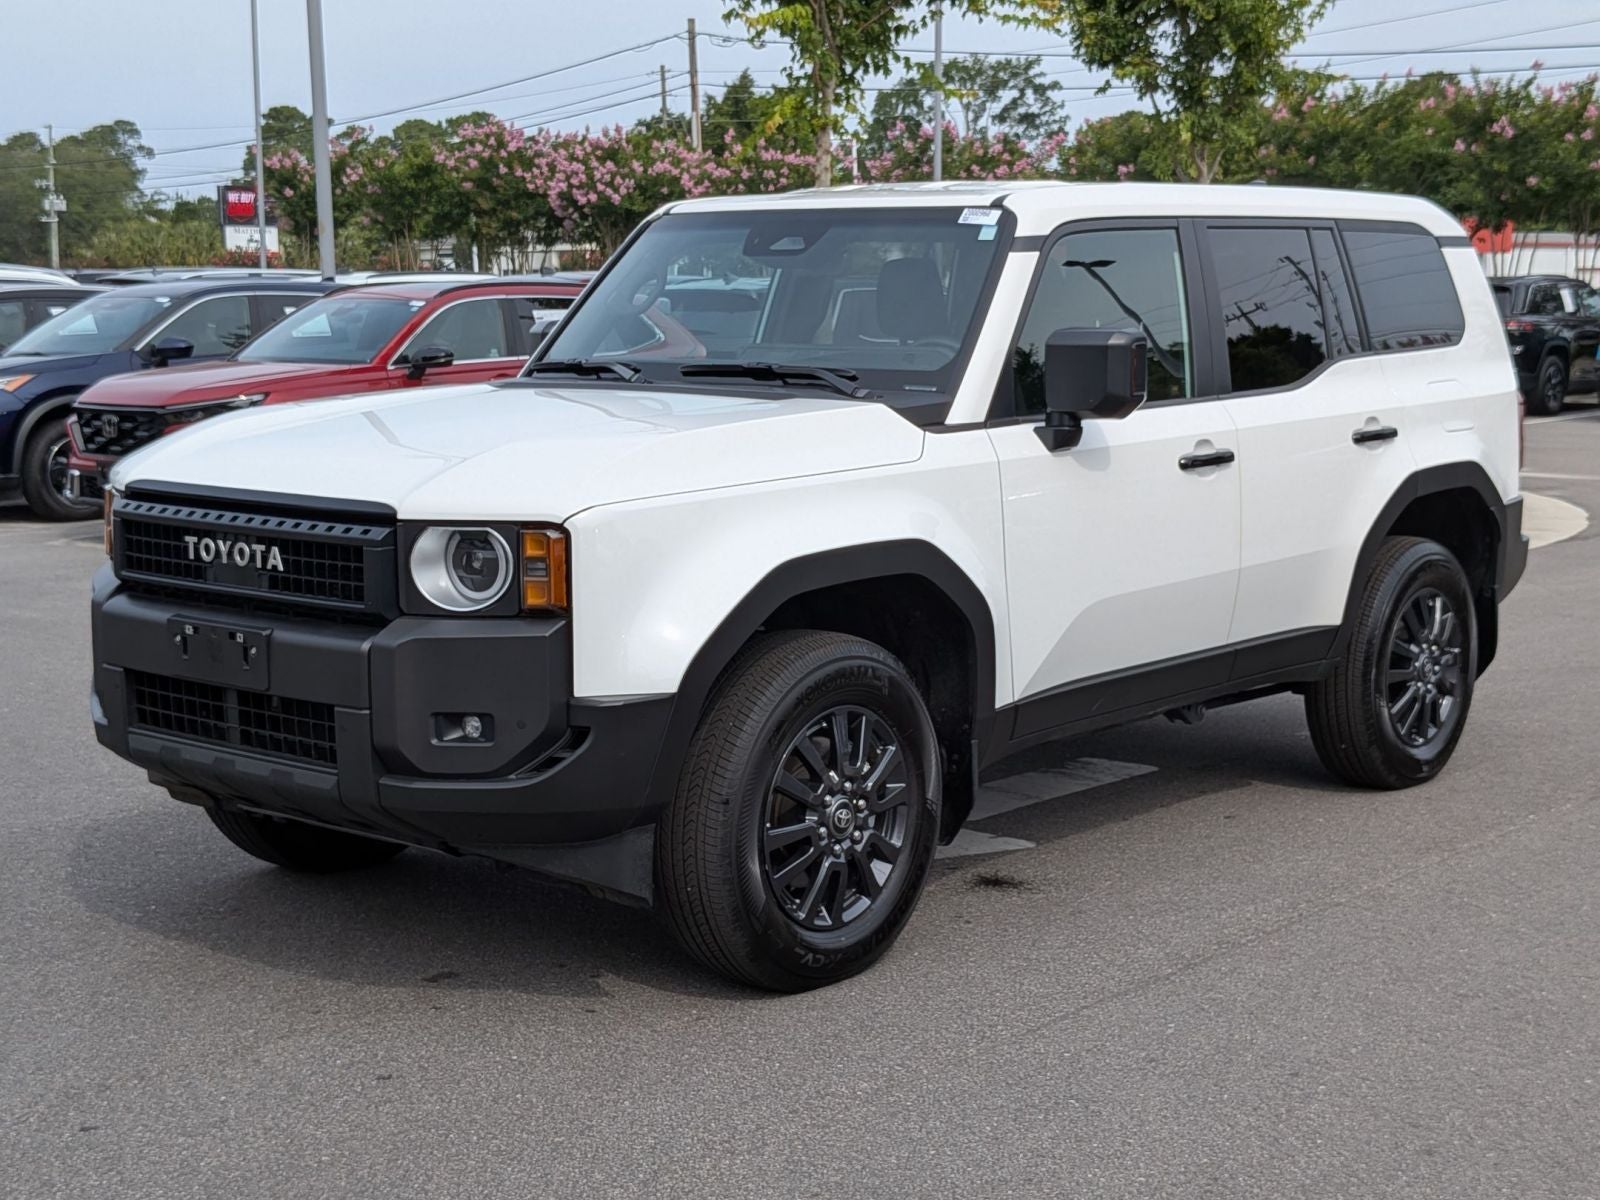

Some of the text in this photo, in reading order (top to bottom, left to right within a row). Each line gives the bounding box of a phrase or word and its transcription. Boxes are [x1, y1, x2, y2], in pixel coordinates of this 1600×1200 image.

[228, 192, 256, 204] WE BUY
[184, 535, 284, 572] TOYOTA
